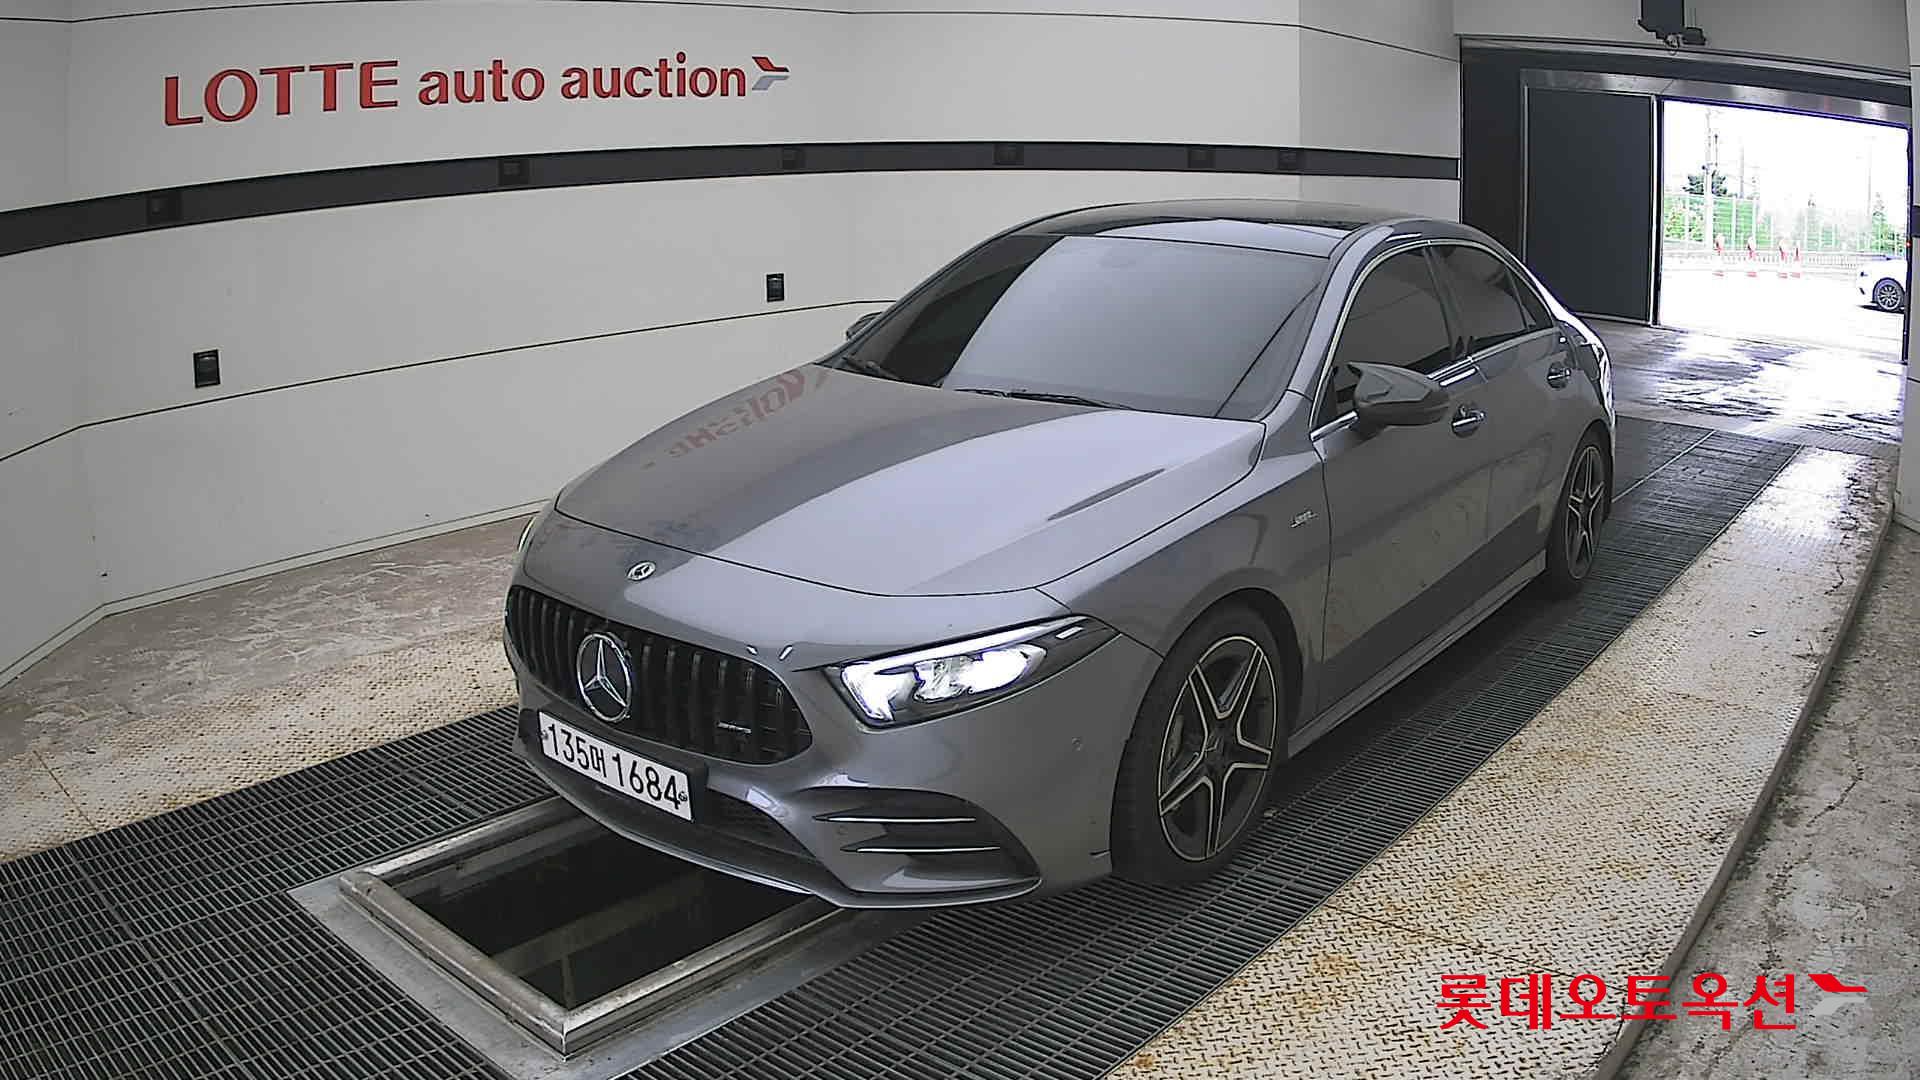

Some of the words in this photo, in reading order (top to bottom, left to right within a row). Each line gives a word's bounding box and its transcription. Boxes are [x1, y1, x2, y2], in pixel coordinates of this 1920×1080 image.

[165, 61, 399, 126] LOTTE
[418, 59, 544, 104] auto
[561, 52, 747, 99] auction
[612, 753, 681, 810] 1684
